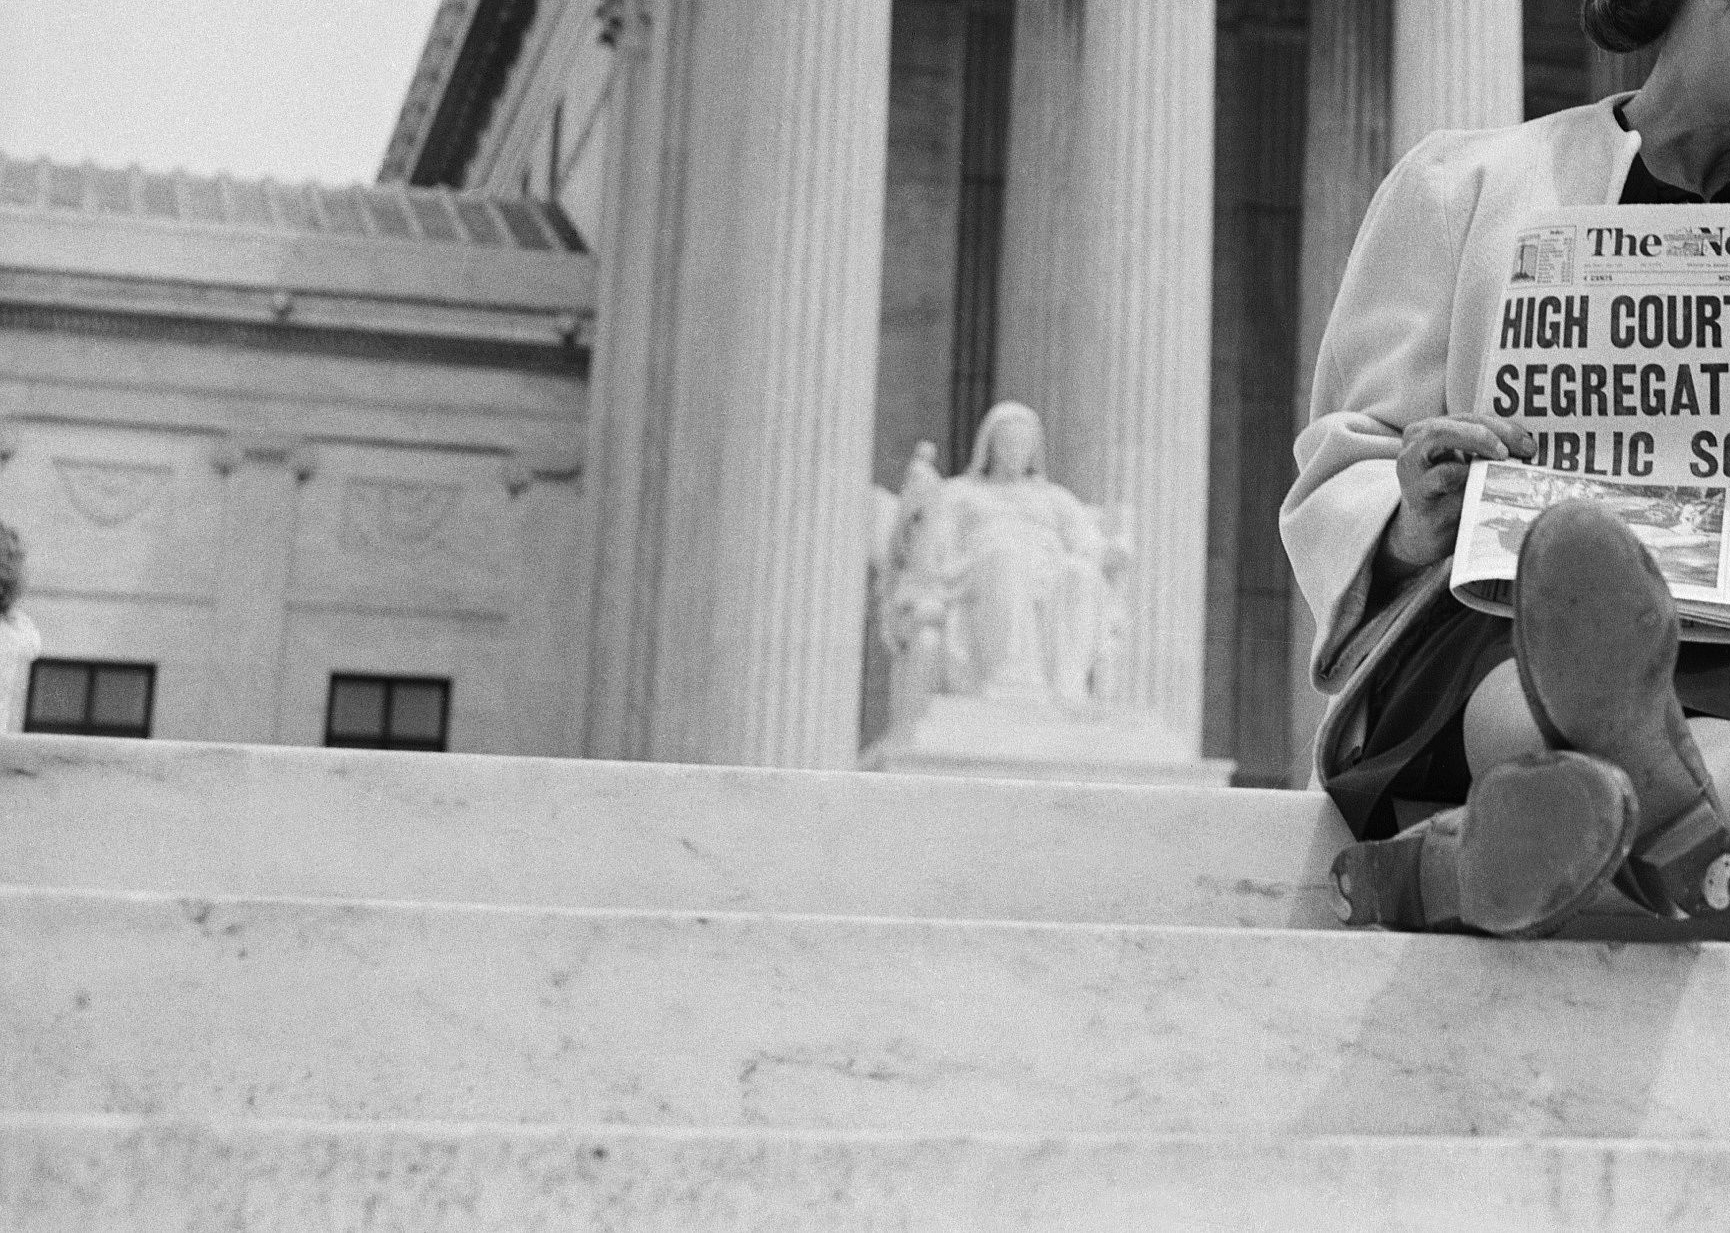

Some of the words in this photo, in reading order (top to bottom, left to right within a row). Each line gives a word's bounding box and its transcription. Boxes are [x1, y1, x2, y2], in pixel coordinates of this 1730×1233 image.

[1587, 228, 1662, 257] The
[1501, 296, 1588, 348] HIGH
[1522, 432, 1653, 476] UBLIC
